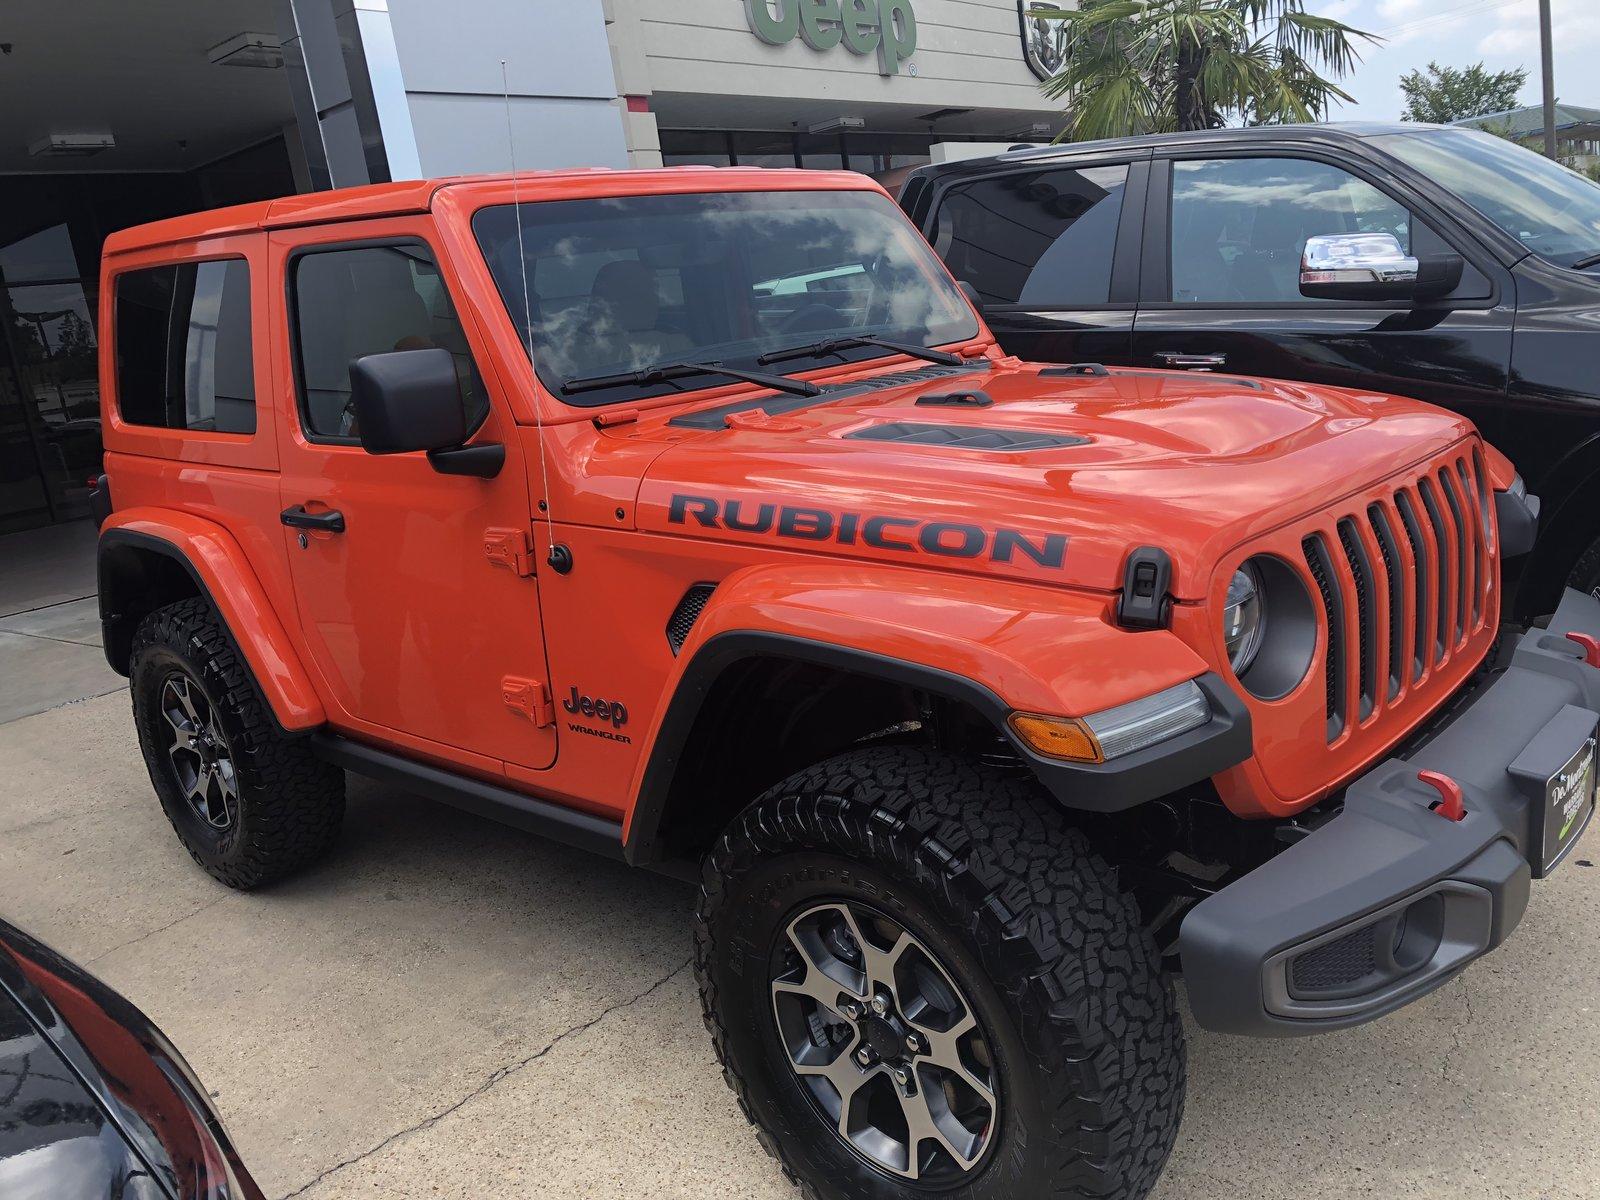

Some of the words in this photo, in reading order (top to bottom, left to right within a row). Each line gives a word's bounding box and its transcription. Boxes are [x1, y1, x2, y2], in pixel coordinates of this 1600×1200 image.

[667, 493, 1070, 570] RUBICON
[562, 685, 628, 729] Jeep
[568, 722, 632, 745] WRANGLER
